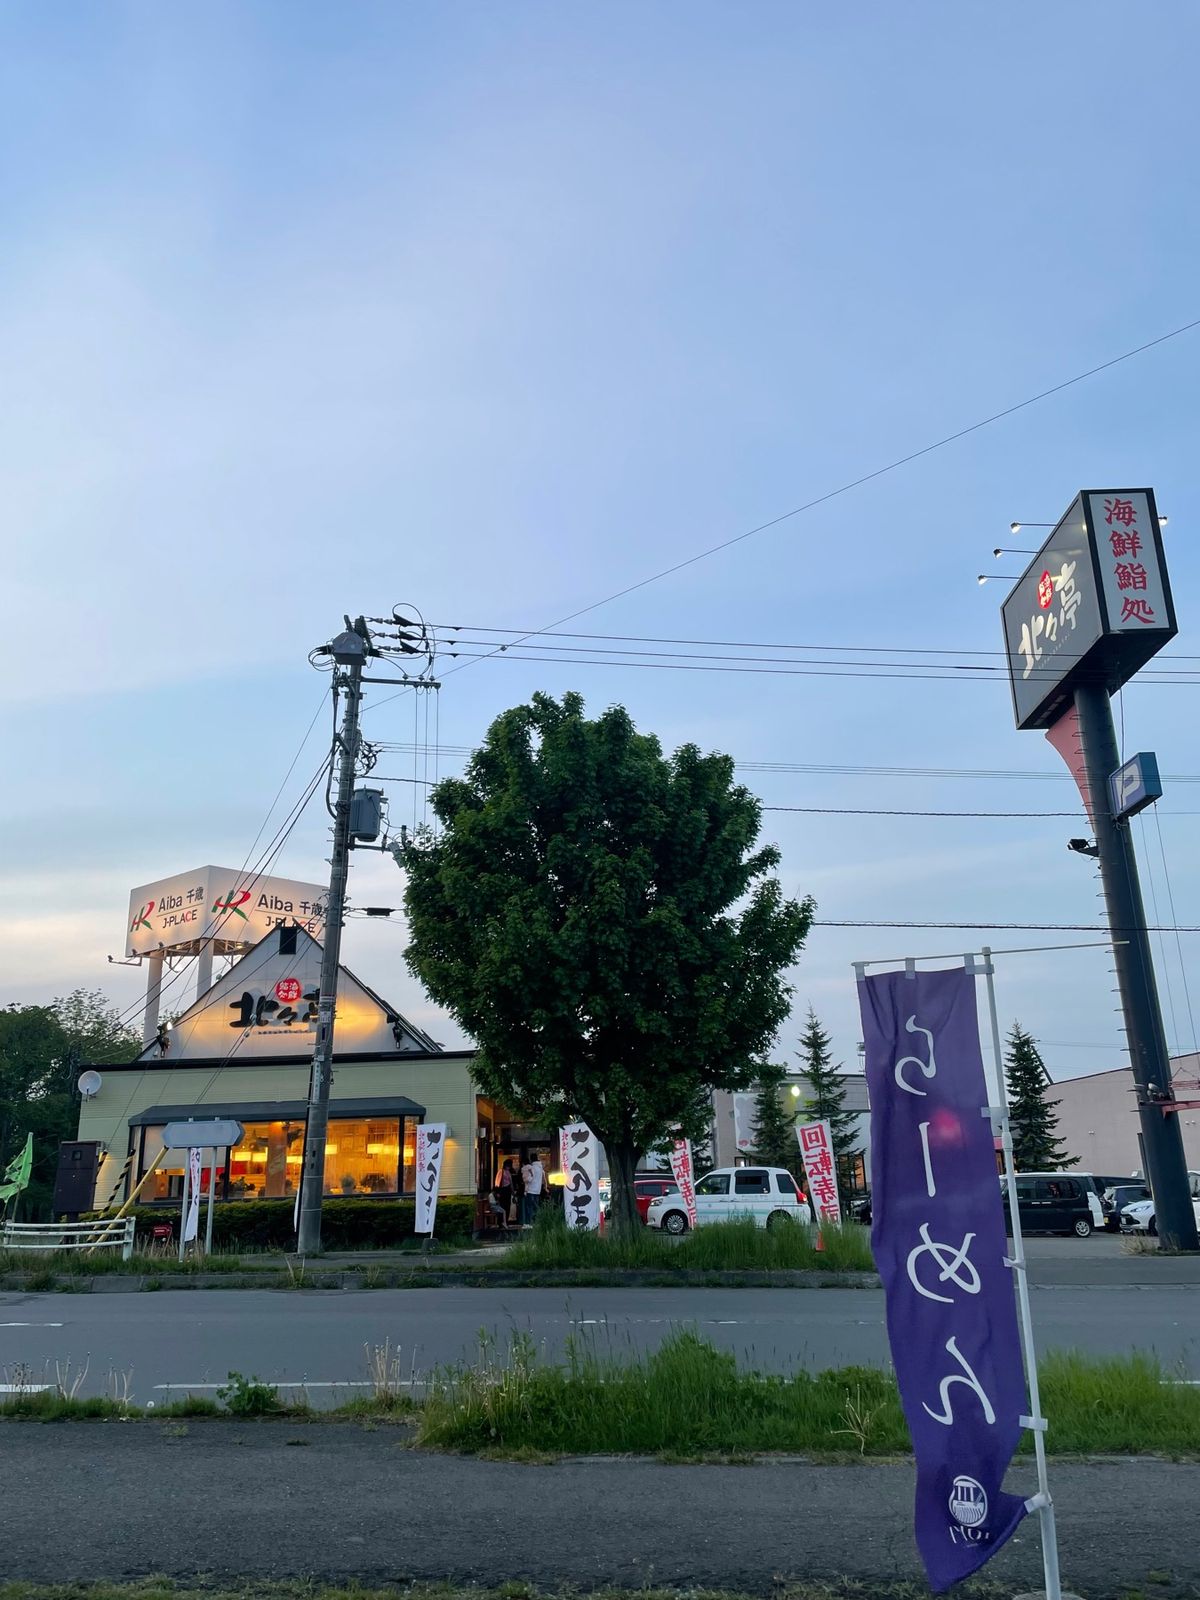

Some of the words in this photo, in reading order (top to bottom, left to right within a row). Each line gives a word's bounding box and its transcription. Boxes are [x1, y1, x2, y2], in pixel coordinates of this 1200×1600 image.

[1104, 497, 1155, 624] 海鮮鮨処
[1018, 560, 1082, 680] 北々亭
[1115, 763, 1141, 811] P
[158, 894, 183, 913] Aiba
[186, 886, 204, 904] 千歳
[257, 894, 293, 913] Aiba
[162, 908, 197, 929] J-PLACE
